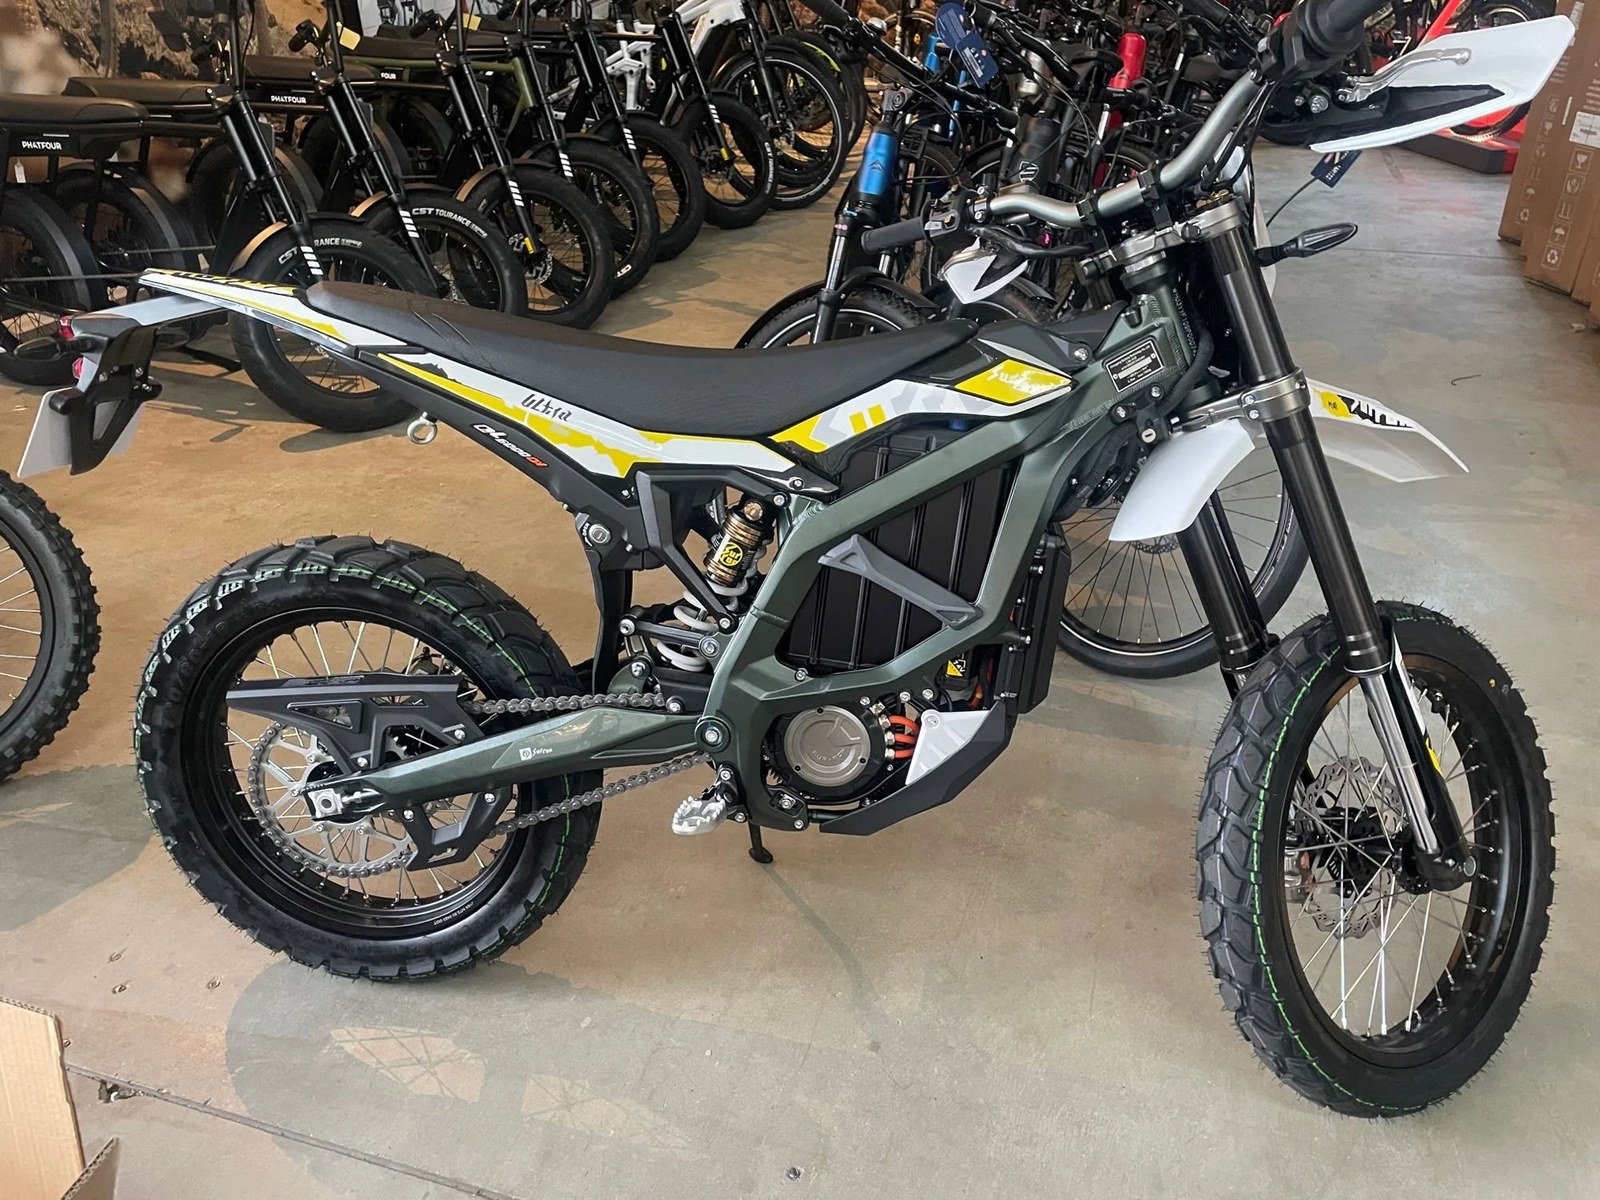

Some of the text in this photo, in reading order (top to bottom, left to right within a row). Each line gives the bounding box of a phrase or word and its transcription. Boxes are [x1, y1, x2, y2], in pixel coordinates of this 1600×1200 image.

[270, 95, 307, 104] PHATFOUR
[21, 140, 63, 150] PHATFOUR
[411, 207, 472, 227] CST TOURANCE
[278, 246, 298, 265] CST
